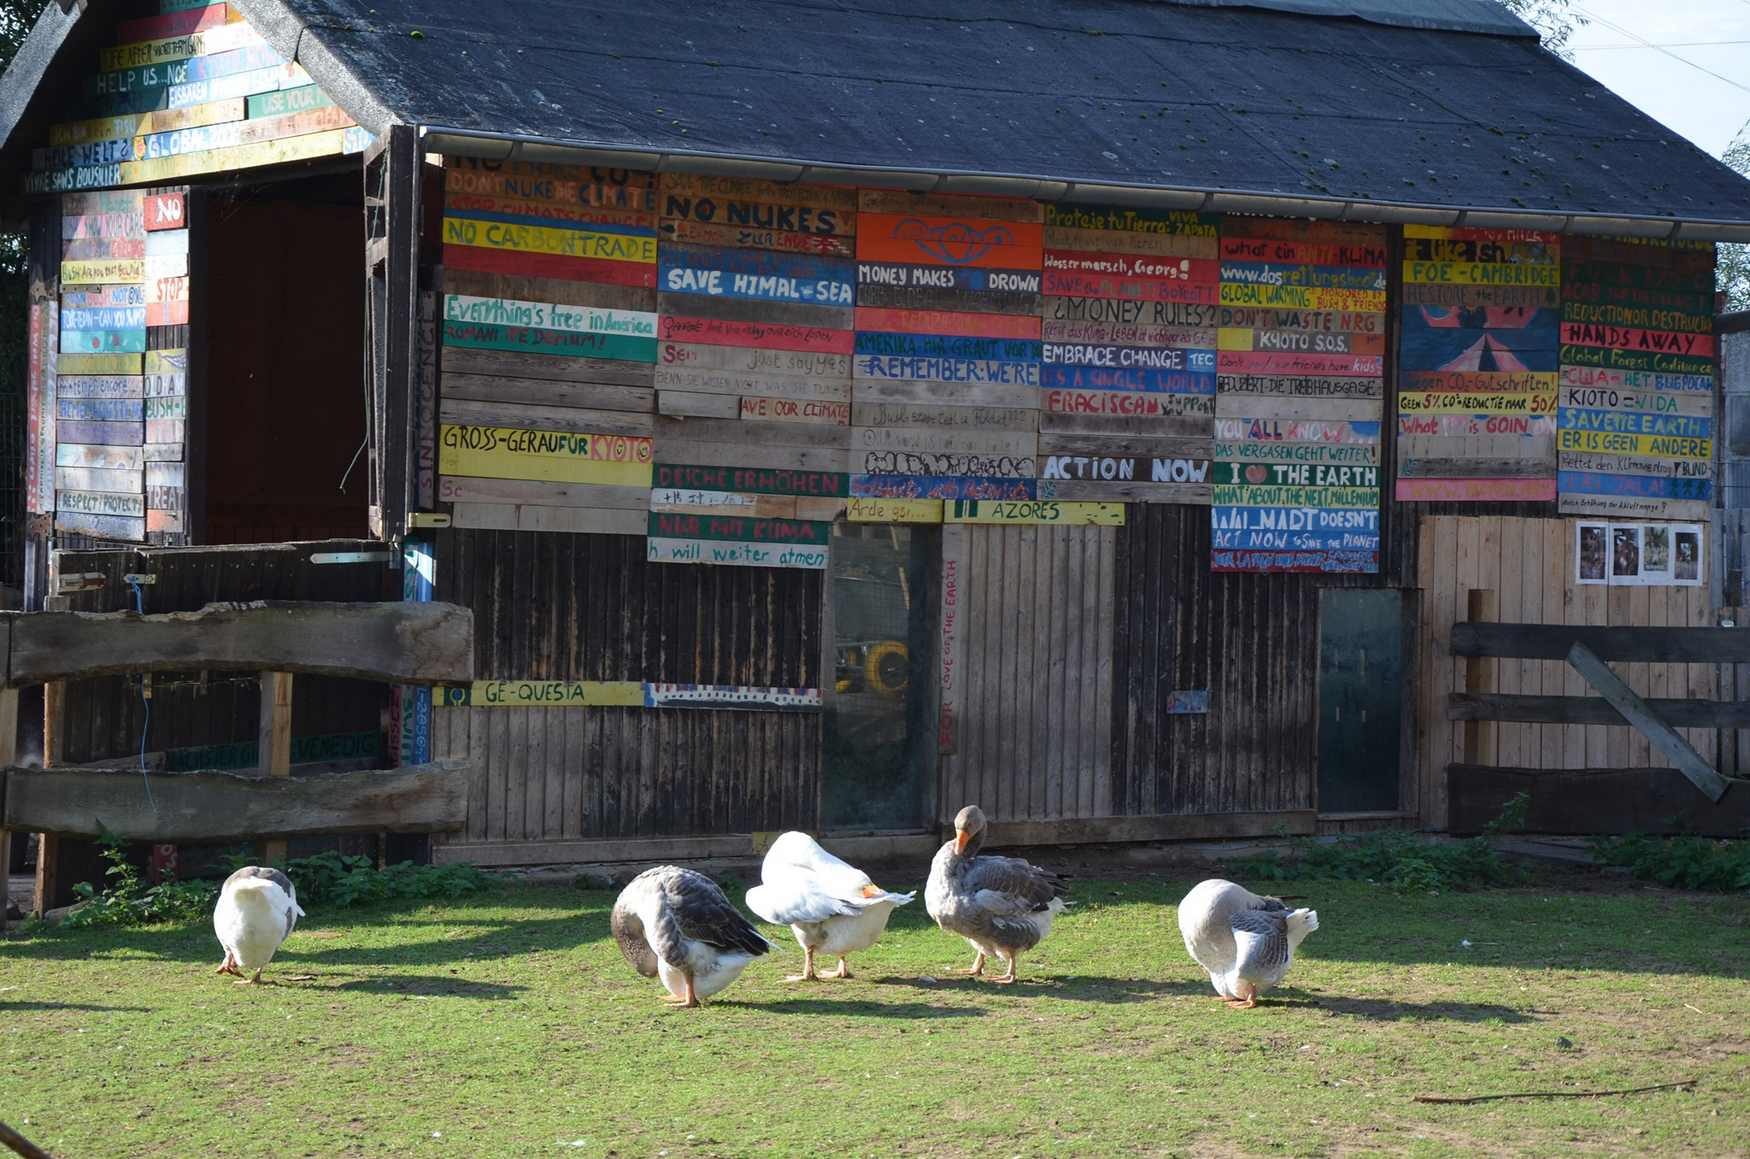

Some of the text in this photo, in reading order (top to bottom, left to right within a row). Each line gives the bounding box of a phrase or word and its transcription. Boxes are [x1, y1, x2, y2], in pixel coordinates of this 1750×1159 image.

[156, 198, 181, 223] NO
[666, 195, 837, 234] NO NUKES
[449, 222, 477, 244] NO
[577, 237, 655, 260] TRADE
[667, 268, 723, 294] SAVE
[858, 264, 1040, 292] MONEY MAKES DROWN
[1413, 263, 1453, 281] FOE
[157, 278, 184, 301] STOP
[1221, 283, 1262, 305] GLOBAL
[1263, 286, 1312, 307] WARMING
[552, 303, 582, 330] free
[1221, 308, 1376, 332] DON'T WASTE NRG
[1569, 323, 1695, 355] HANDS AWAY
[789, 354, 813, 376] say
[1043, 344, 1214, 370] EMBRACE CHANGE TEC
[774, 401, 799, 416] OUR
[1568, 388, 1618, 407] KIOTO
[1216, 418, 1282, 442] YOU ALL
[1401, 416, 1529, 434] What is GOIN
[1642, 415, 1700, 436] EARTH
[1216, 444, 1233, 457] DAS
[1238, 444, 1291, 459] VERGASEN
[1295, 446, 1326, 460] GEHT
[1563, 431, 1709, 457] ER IS GEEN ANDERE
[1151, 458, 1209, 482] NOW
[1230, 463, 1377, 486] I THE EARTH
[992, 502, 1060, 520] AZORES
[1320, 511, 1378, 529] DOESN'T
[1215, 531, 1242, 548] ACT
[1249, 532, 1287, 548] NOW
[672, 544, 825, 566] will weiter atmen
[944, 559, 957, 606] EARTH
